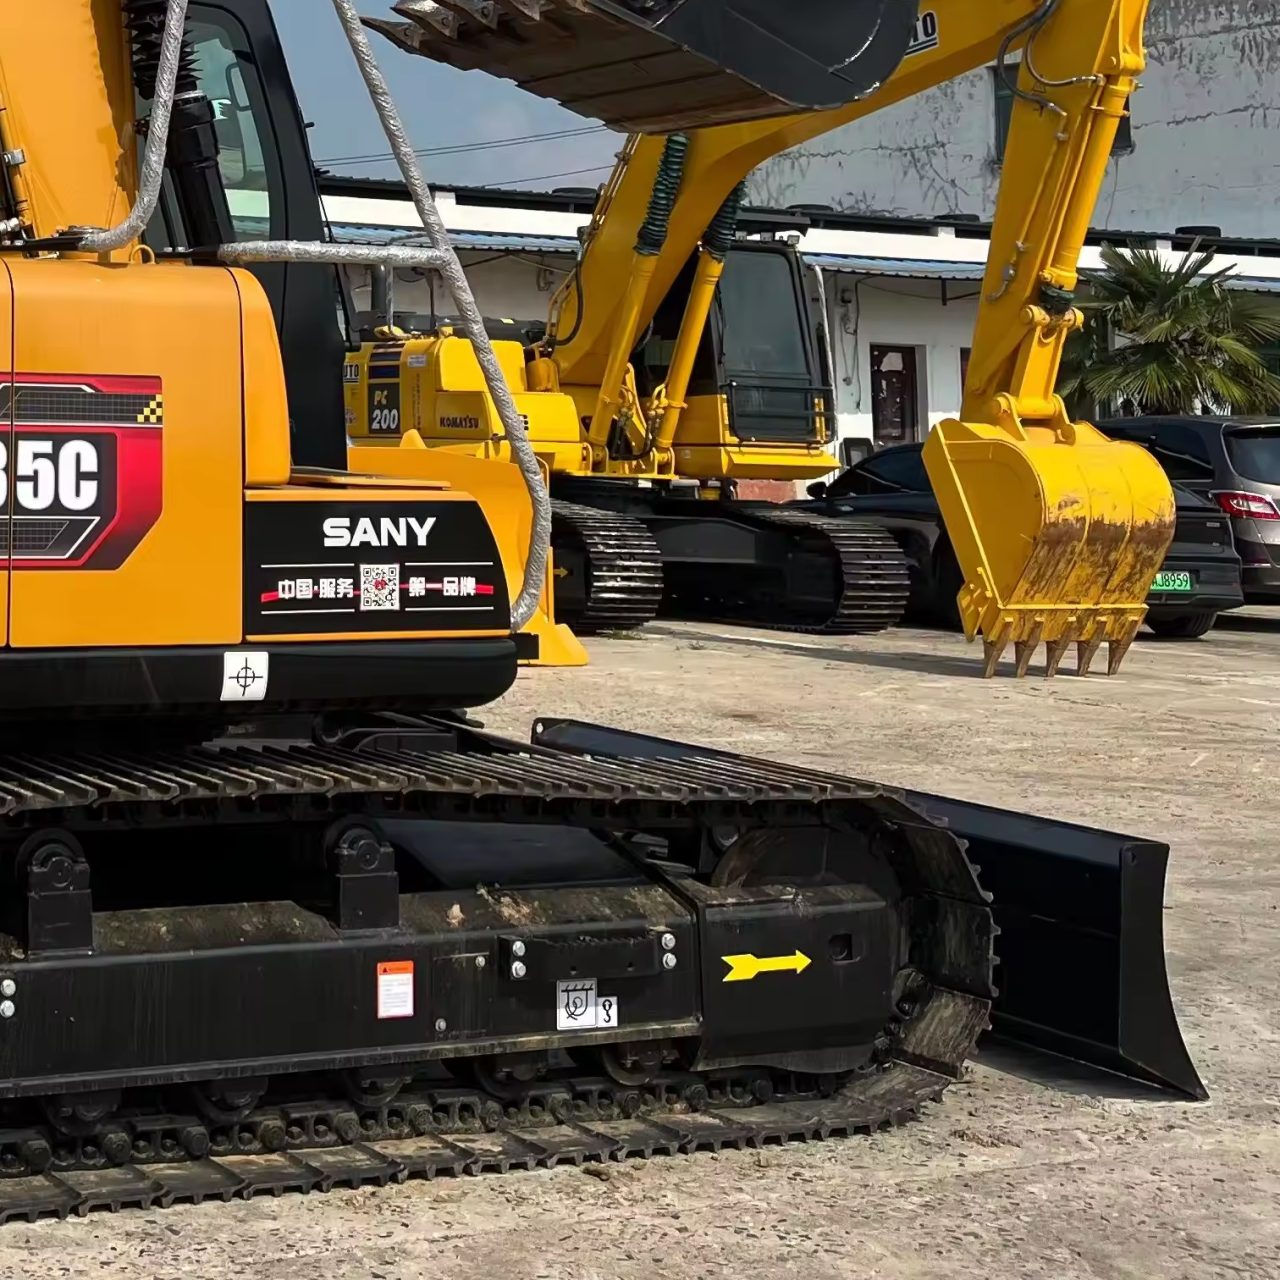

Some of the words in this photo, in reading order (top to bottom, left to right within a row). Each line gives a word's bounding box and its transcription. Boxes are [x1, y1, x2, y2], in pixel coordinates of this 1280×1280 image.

[374, 390, 388, 405] PC
[371, 409, 399, 430] 200
[439, 415, 479, 428] KOMATSU
[322, 517, 437, 547] SANY
